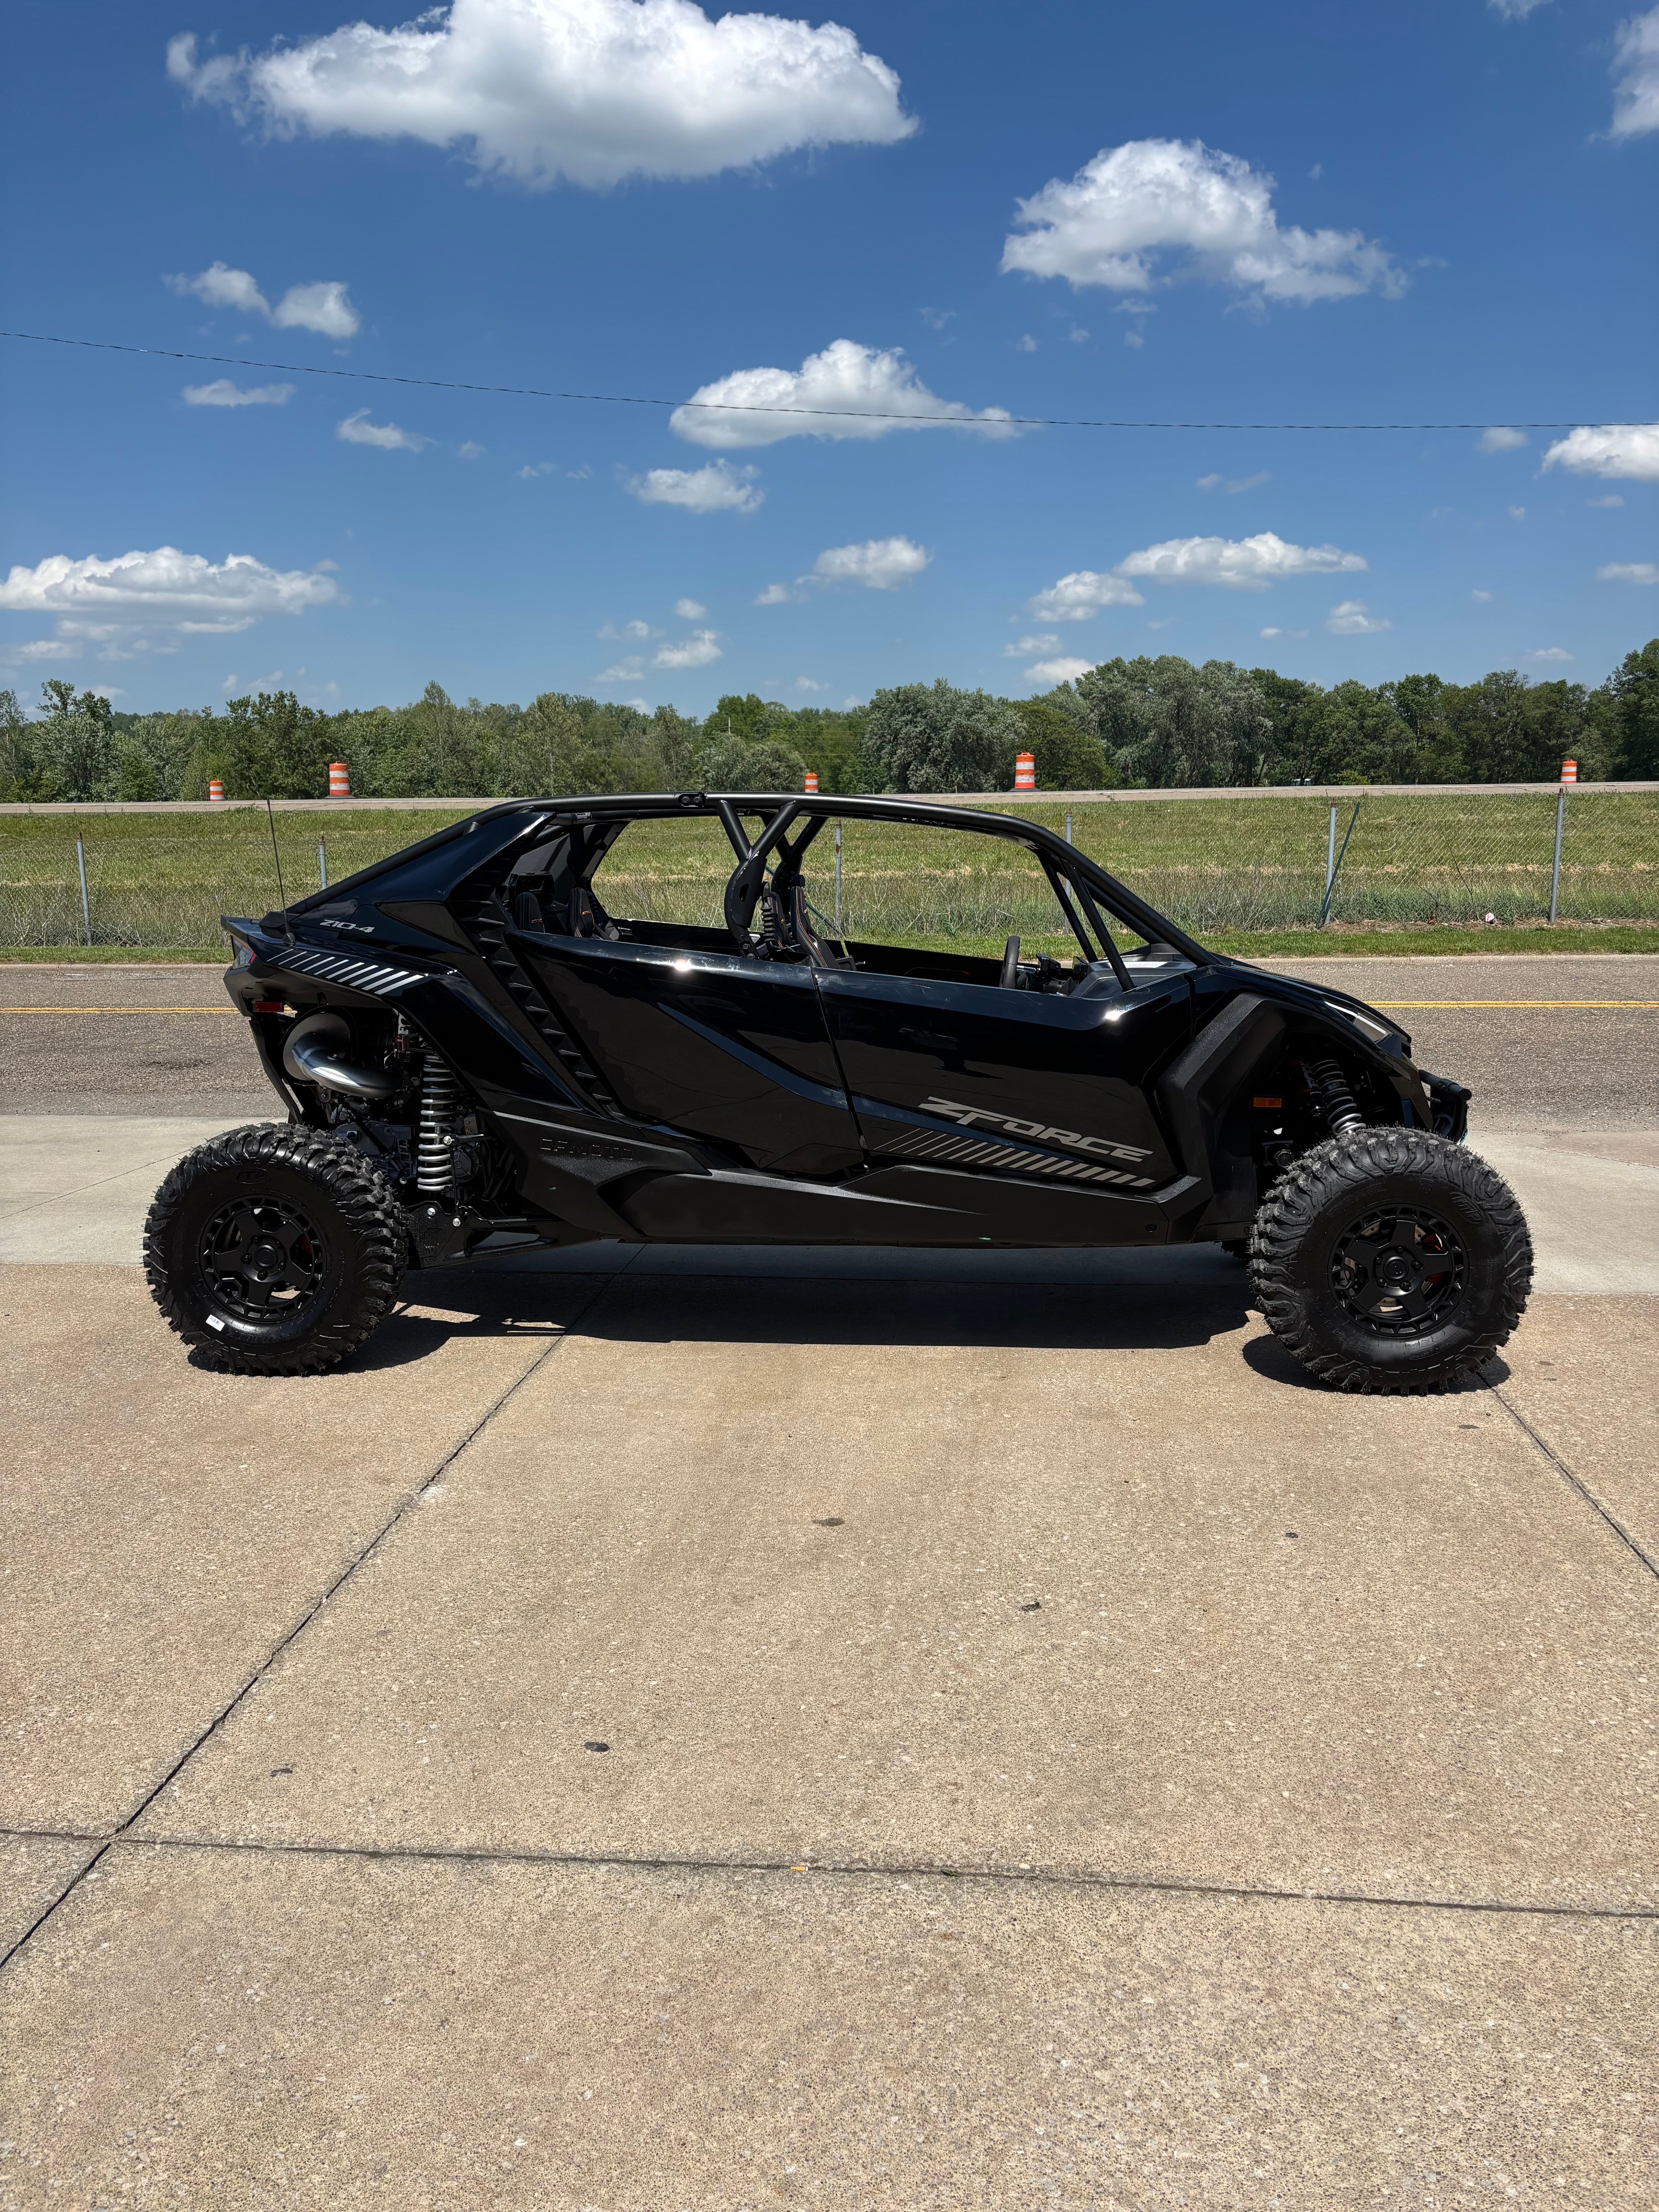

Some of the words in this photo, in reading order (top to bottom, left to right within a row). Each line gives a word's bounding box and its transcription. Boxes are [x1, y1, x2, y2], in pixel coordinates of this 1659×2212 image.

[319, 919, 375, 933] Z10-4
[918, 1096, 1153, 1162] ZFORCE
[539, 1137, 635, 1160] CFMOTO
[235, 1170, 266, 1181] ITP
[1451, 1196, 1482, 1221] ITP
